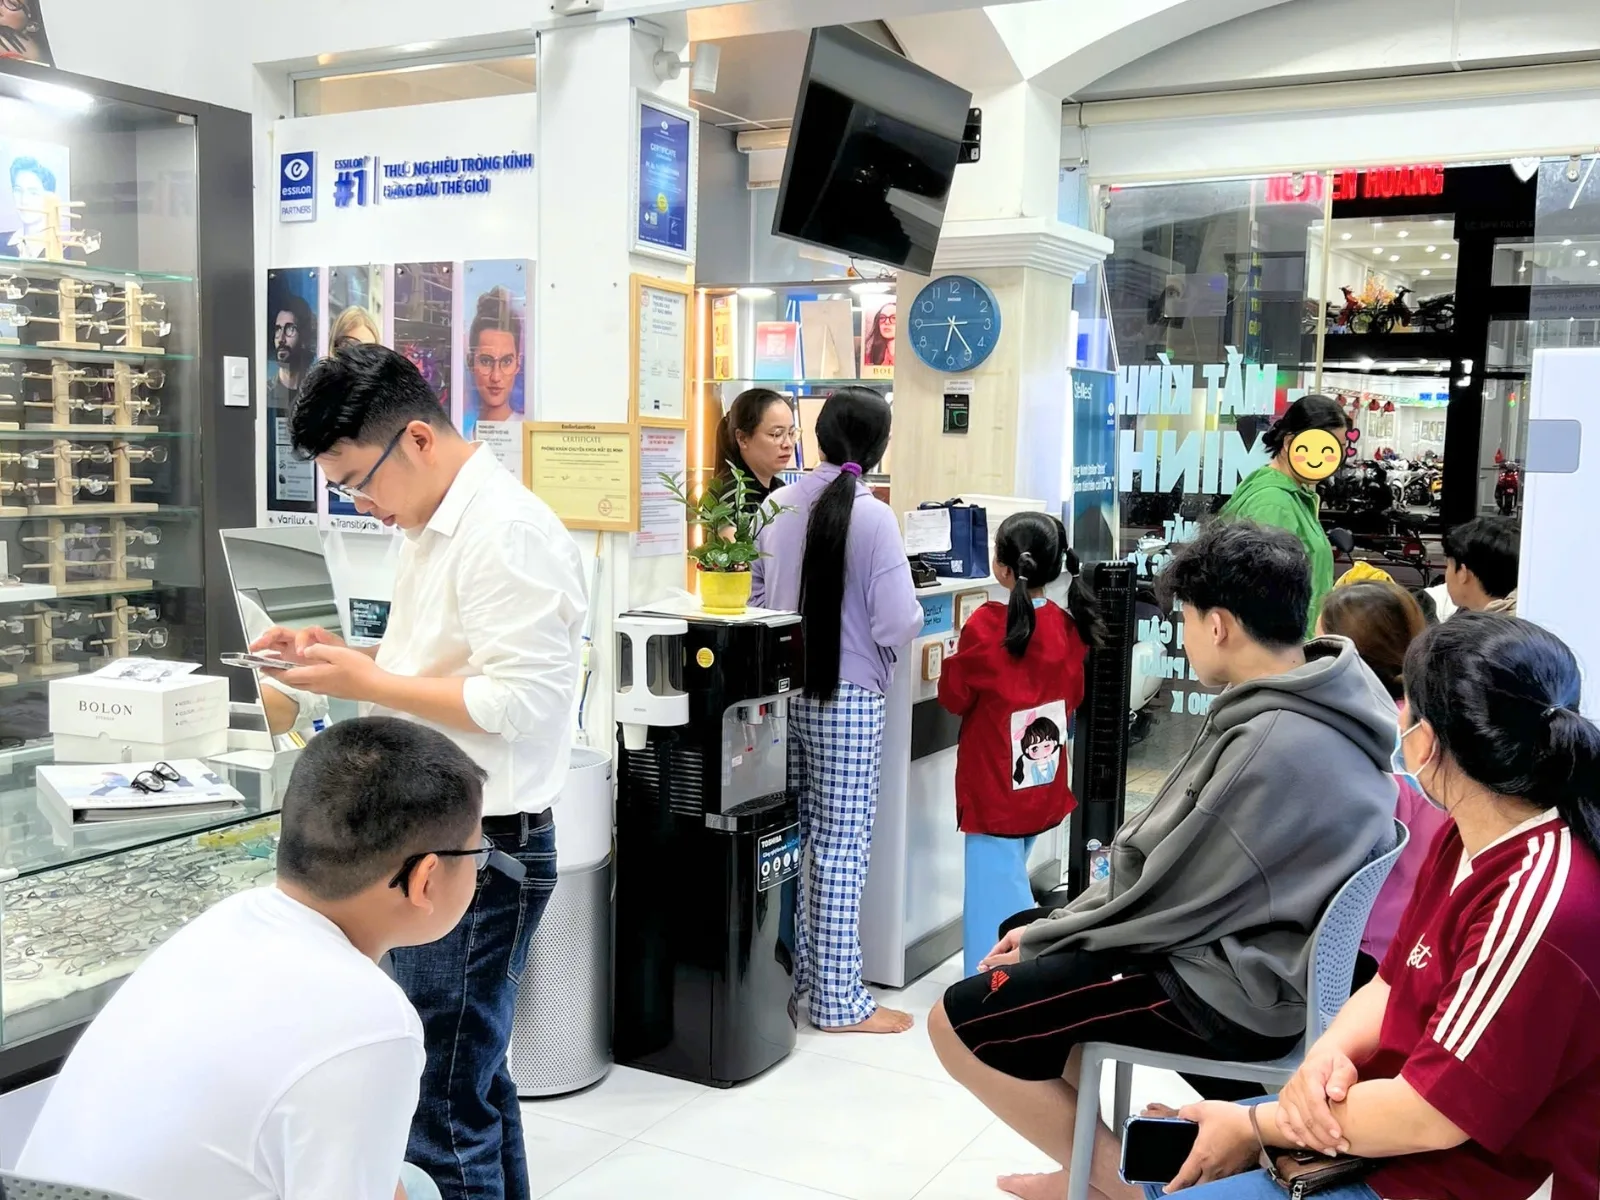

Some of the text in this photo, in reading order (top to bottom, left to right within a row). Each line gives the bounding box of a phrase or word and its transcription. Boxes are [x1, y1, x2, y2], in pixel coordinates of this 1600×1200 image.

[503, 150, 533, 169] KÍNH
[333, 169, 367, 207] #1
[281, 205, 312, 215] PARTNERS
[932, 287, 940, 299] 11
[949, 281, 960, 294] 12
[921, 300, 934, 313] 10
[980, 300, 988, 312] 2
[914, 318, 924, 330] 9
[983, 318, 991, 330] 3
[919, 336, 928, 348] 8
[977, 336, 984, 347] 4
[931, 349, 939, 362] 7
[946, 354, 955, 366] 6
[278, 514, 306, 525] Varilux
[79, 700, 133, 716] BOLON
